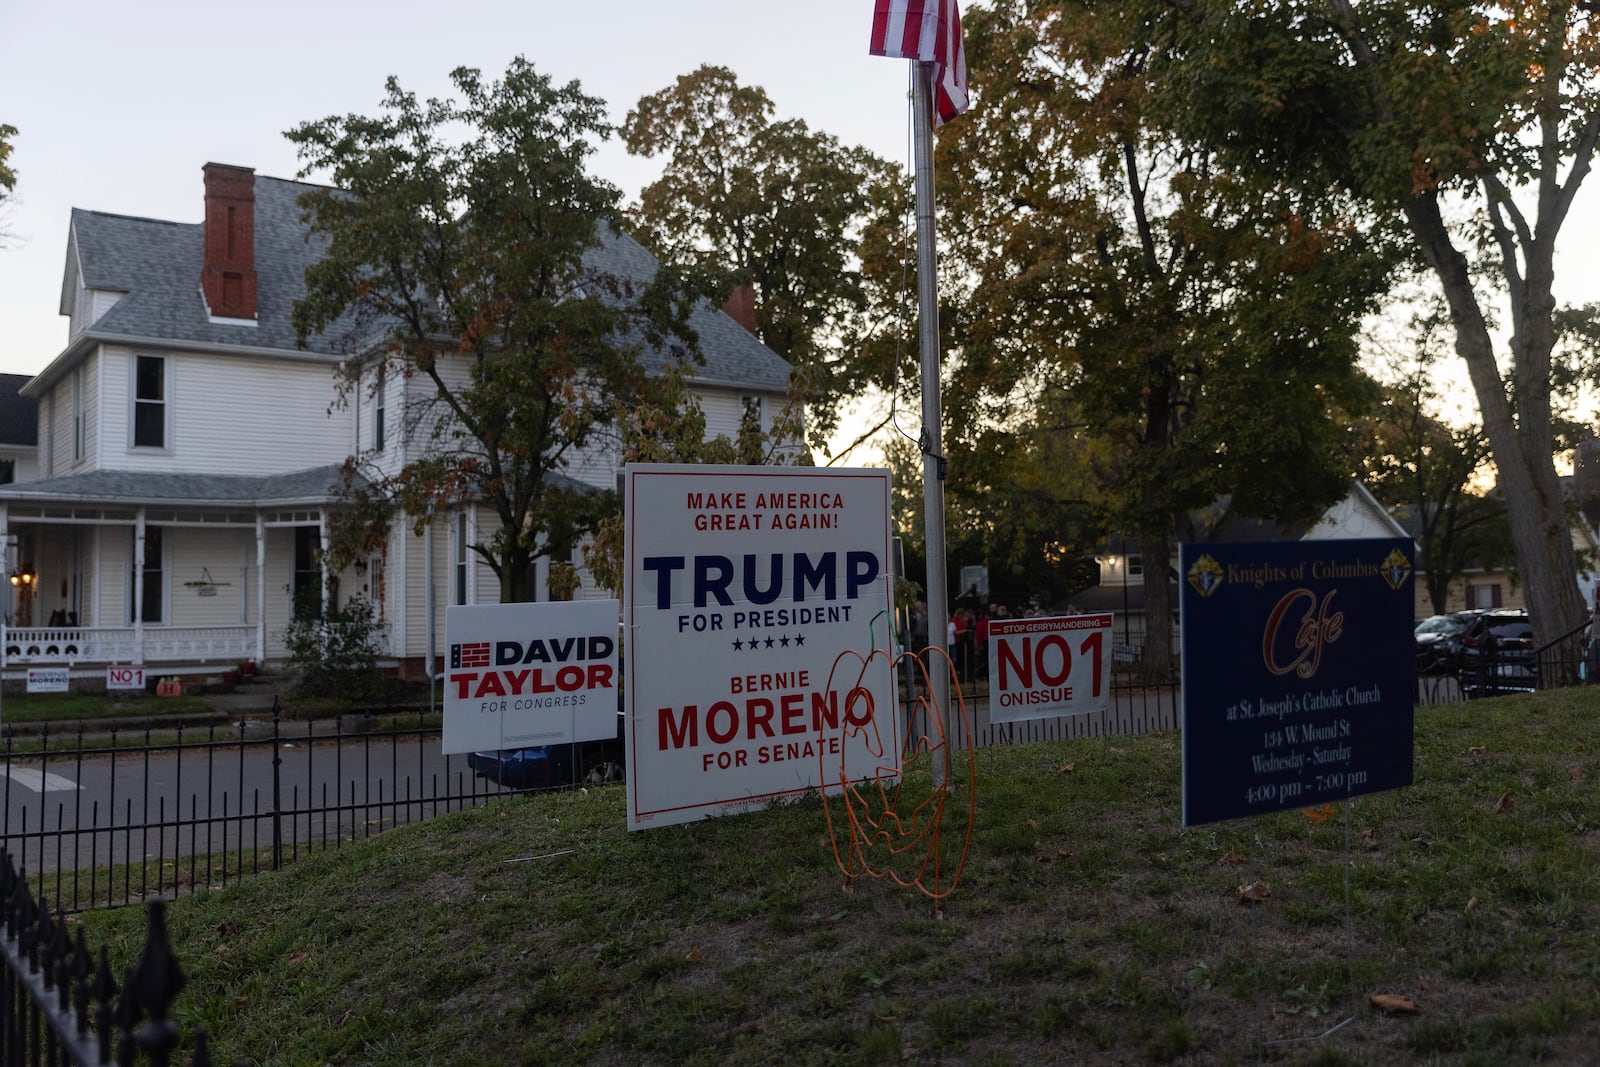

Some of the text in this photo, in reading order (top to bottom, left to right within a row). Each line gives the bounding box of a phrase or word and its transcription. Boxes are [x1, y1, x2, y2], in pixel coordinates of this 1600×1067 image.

[687, 493, 844, 509] MAKE AMERICA
[694, 513, 839, 531] GREAT AGAIN!
[643, 551, 880, 610] TRUMP
[1228, 559, 1378, 589] Knights of Columbus
[678, 606, 852, 632] FOR PRESIDENT
[1003, 619, 1101, 634] STOP GERRYMANDERING
[1262, 588, 1344, 678] Cafe
[495, 636, 614, 666] DAVID
[997, 632, 1103, 697] NO 1
[110, 670, 143, 685] NO 1
[450, 664, 613, 699] TAYLOR
[731, 670, 810, 694] BERNIE
[481, 695, 587, 713] FOR CONGRESS
[1000, 687, 1073, 707] ON ISSUE
[1226, 683, 1381, 721] at St. Joseph's Catholic Church
[658, 686, 875, 751] MORENO
[1264, 719, 1351, 749] 134 W. Mound St
[703, 737, 840, 772] FOR SENATE
[1251, 750, 1305, 774] Wednesday
[1313, 743, 1352, 766] Saturday
[1246, 784, 1276, 804] 4:00
[1280, 782, 1301, 804] pm
[1315, 772, 1344, 791] 7:00
[1347, 771, 1367, 791] pm
